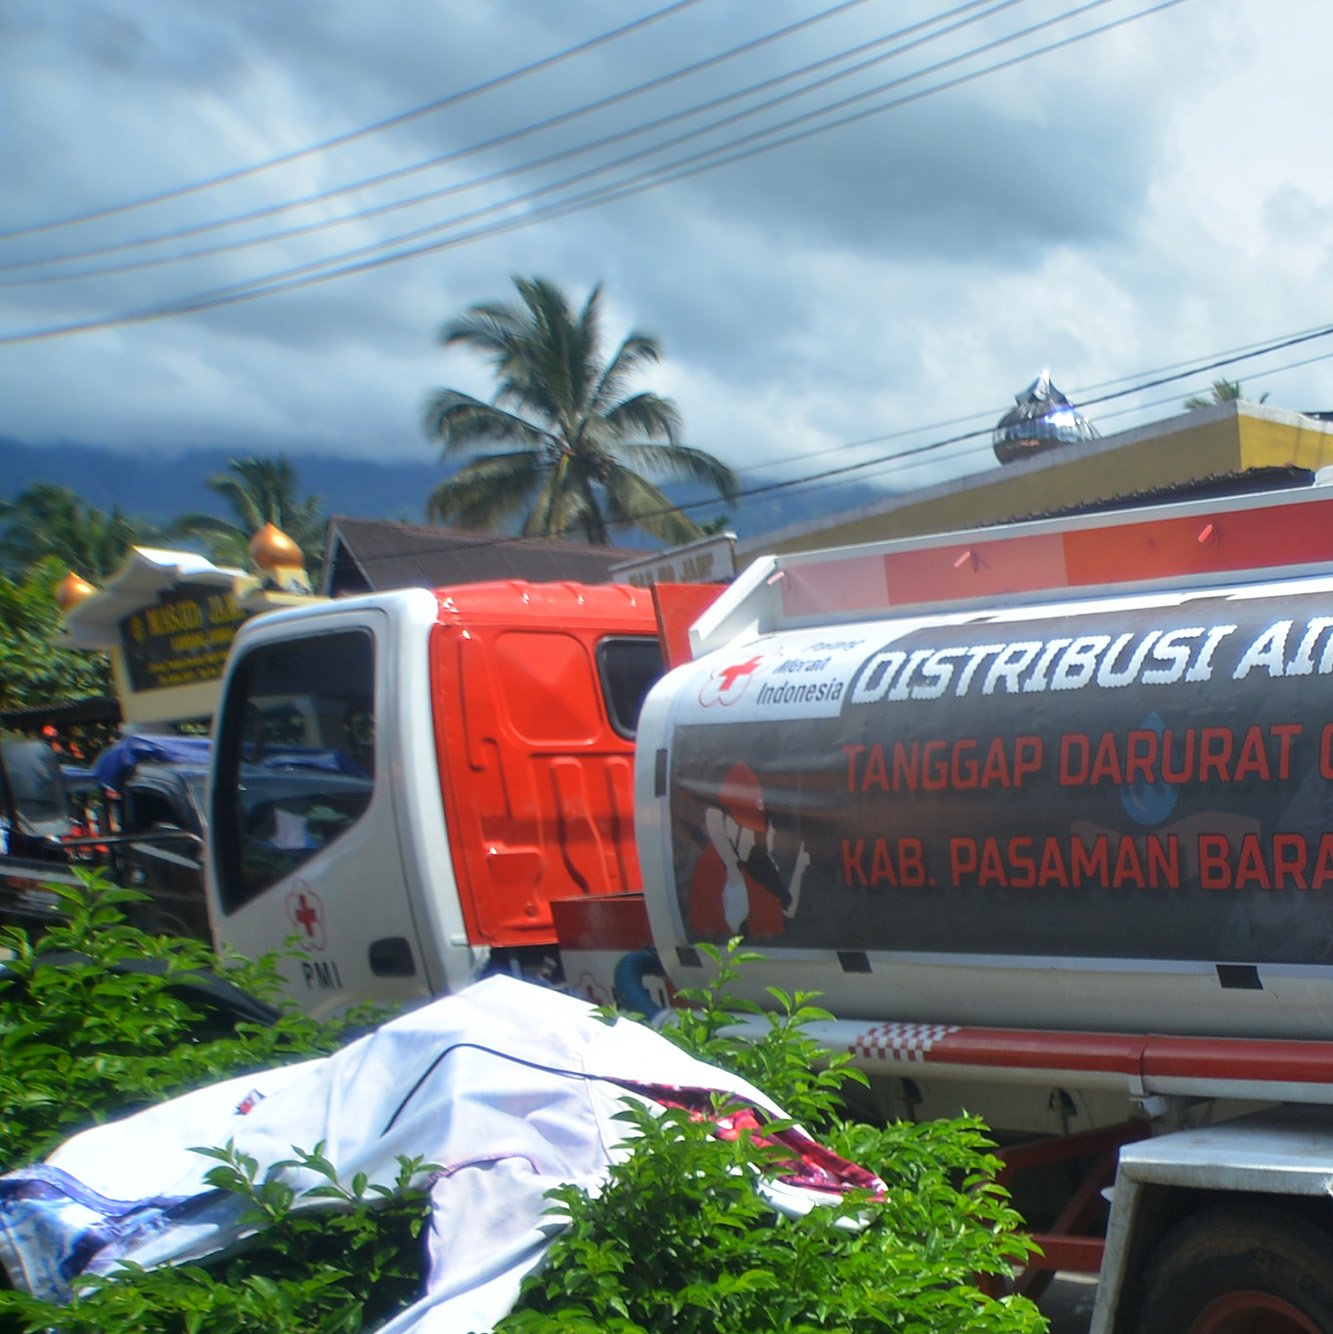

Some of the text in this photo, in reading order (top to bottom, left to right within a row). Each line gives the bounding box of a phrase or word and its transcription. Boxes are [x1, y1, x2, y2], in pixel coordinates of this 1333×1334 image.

[851, 624, 1237, 704] DISTRIBUSI
[756, 678, 844, 706] Indonesia
[841, 734, 1044, 792] TANGGAP
[1059, 722, 1302, 787] DARURAT
[841, 837, 936, 888] KAB.
[949, 834, 1178, 889] PASAMAN
[301, 961, 343, 990] PMI
